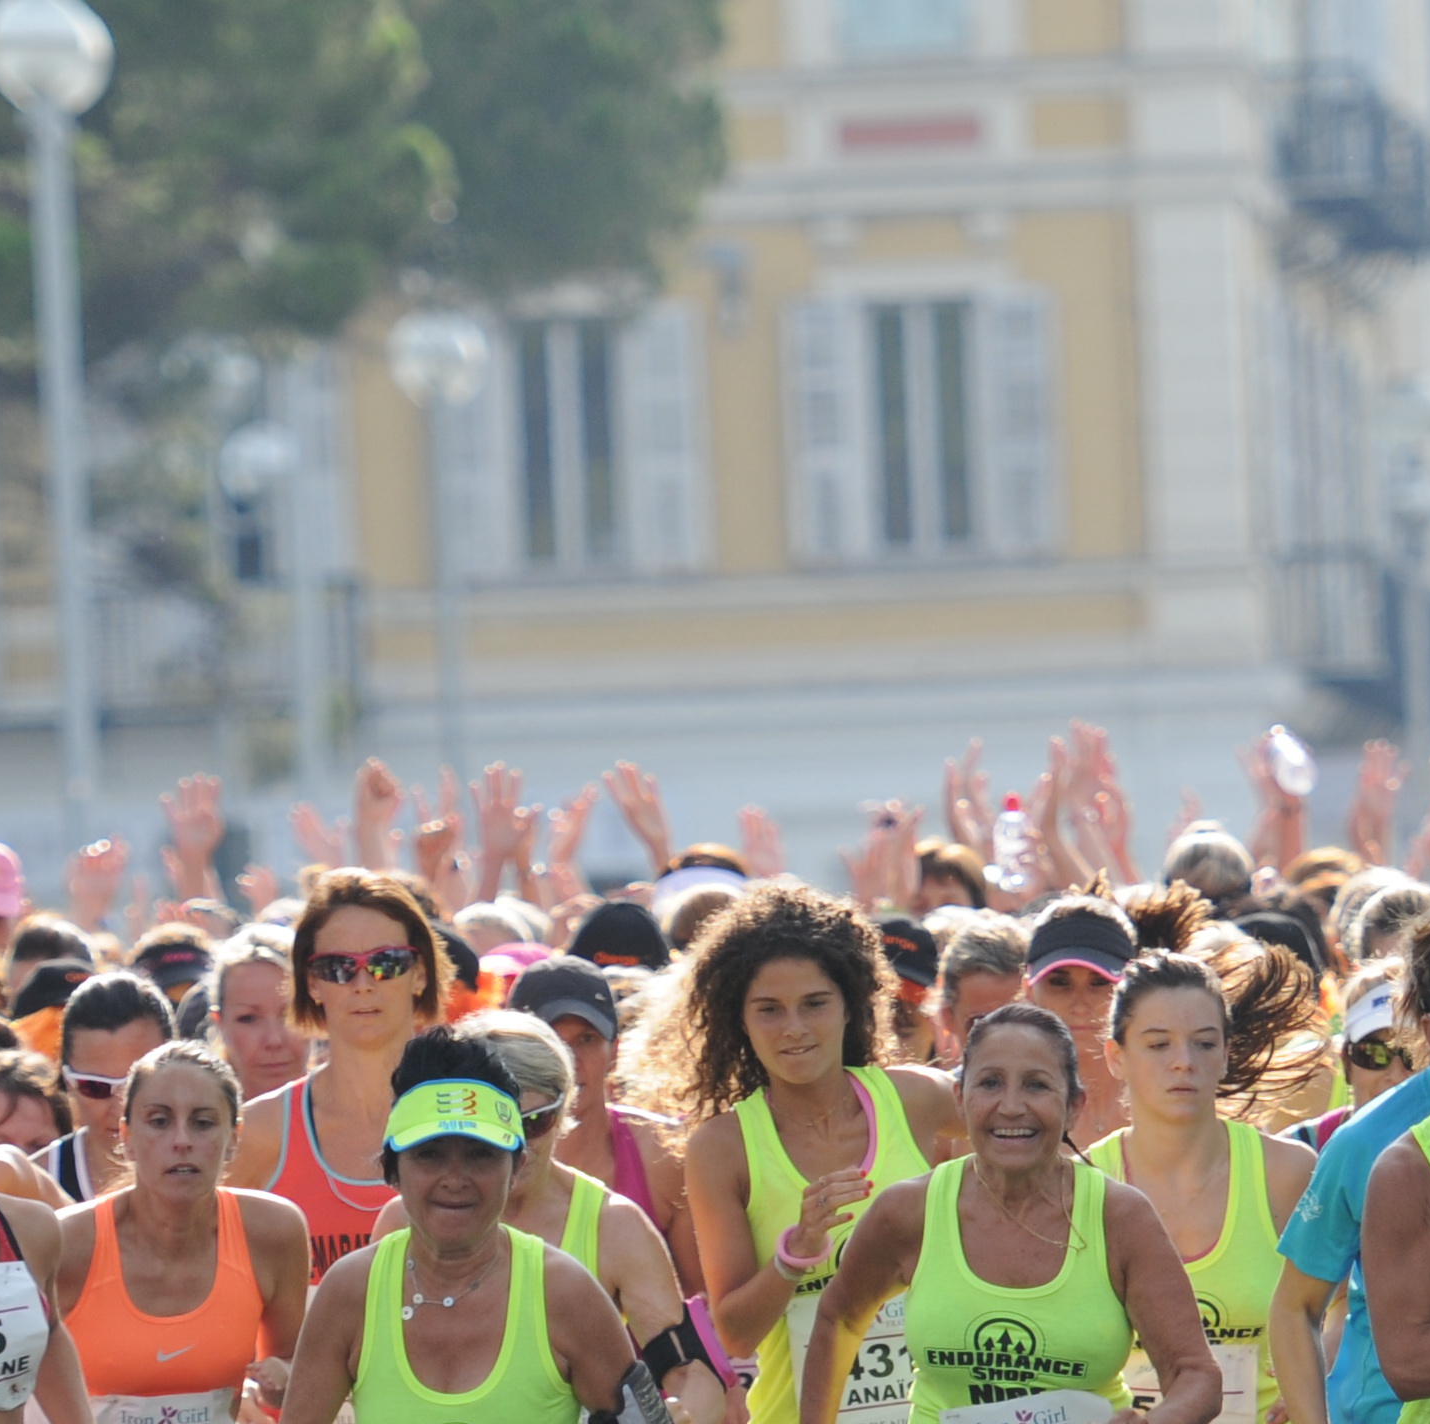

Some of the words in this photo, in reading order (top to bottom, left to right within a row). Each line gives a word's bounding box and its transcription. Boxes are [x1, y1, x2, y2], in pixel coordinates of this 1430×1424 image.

[885, 1301, 903, 1318] Gi
[927, 1350, 1085, 1377] ENDURANCE
[972, 1366, 1036, 1382] SHOP
[177, 1406, 209, 1424] Girl
